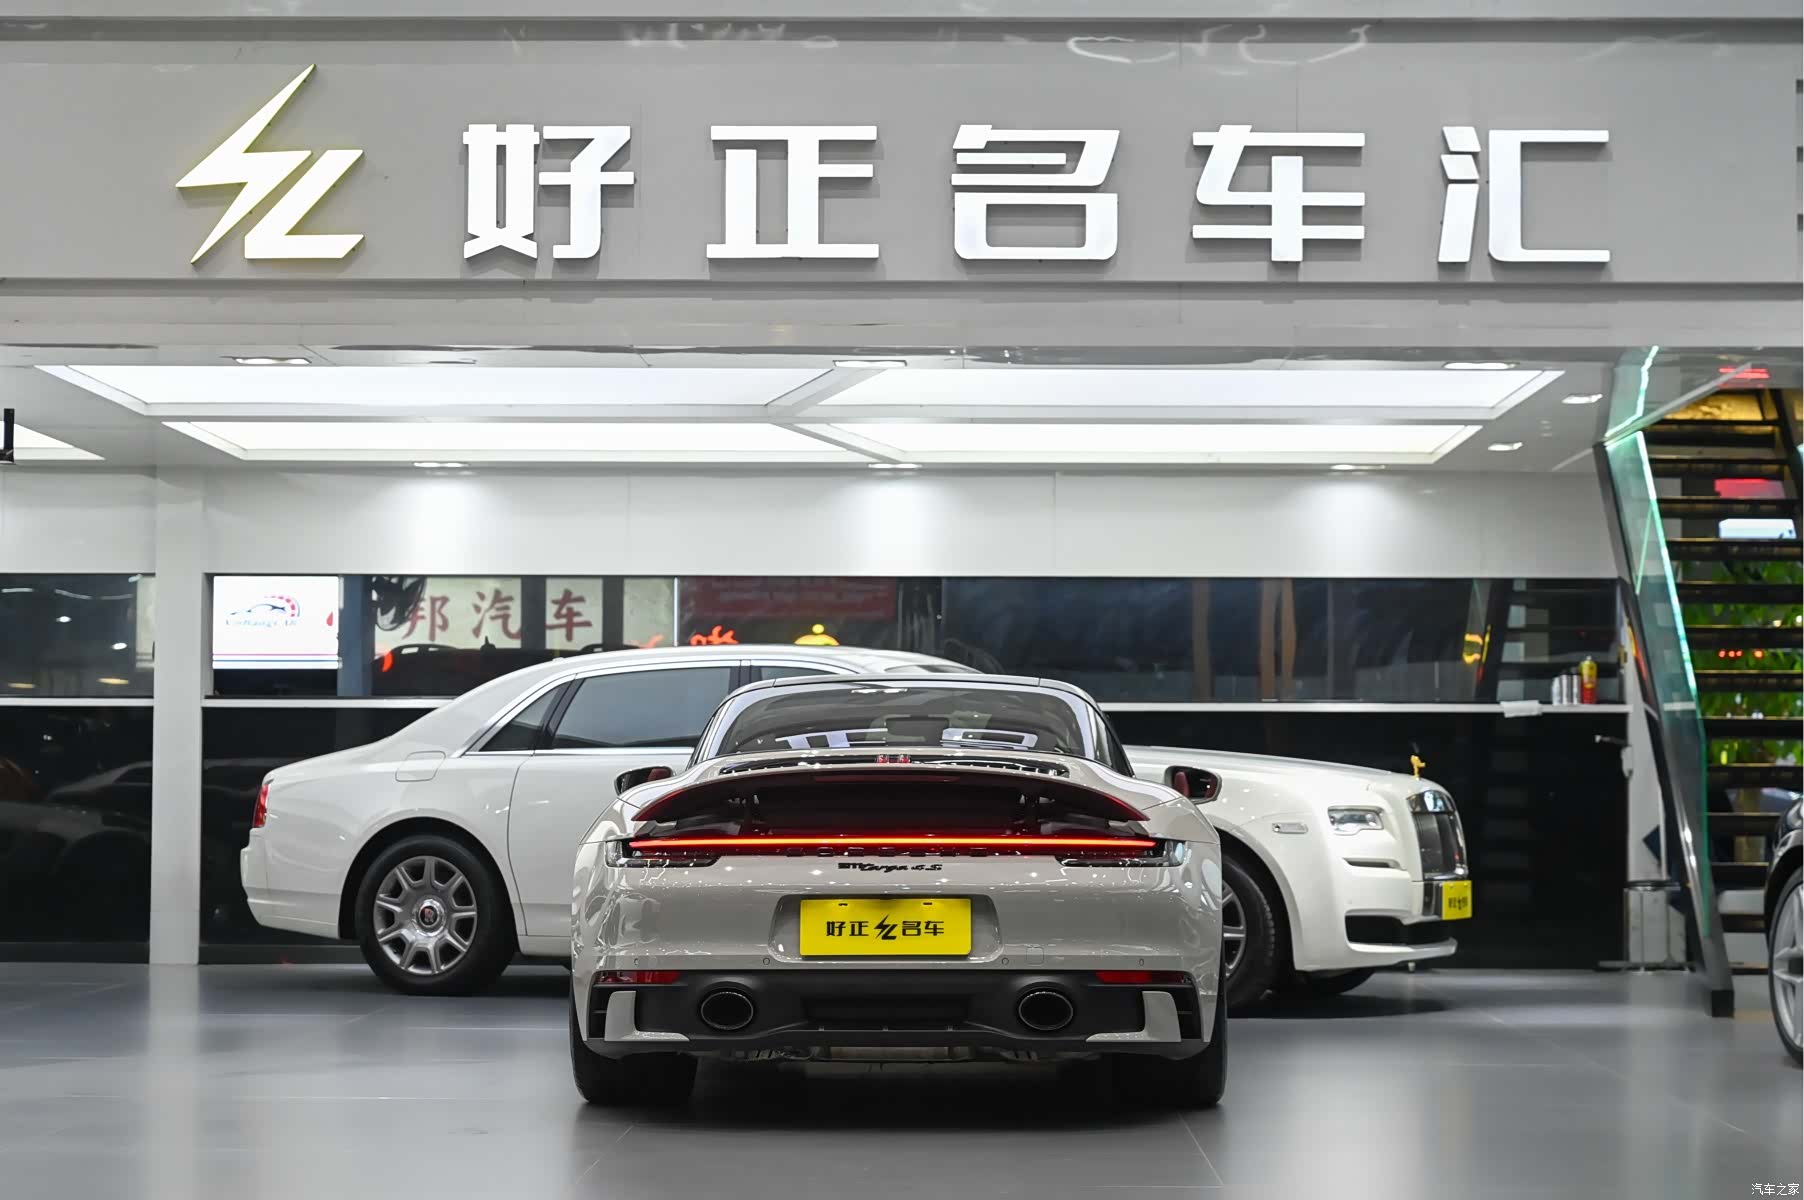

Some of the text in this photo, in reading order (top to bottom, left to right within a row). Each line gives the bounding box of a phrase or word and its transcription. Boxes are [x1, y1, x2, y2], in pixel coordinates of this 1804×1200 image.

[462, 124, 1611, 263] 好正名车汇
[826, 921, 945, 937] 好正 名车
